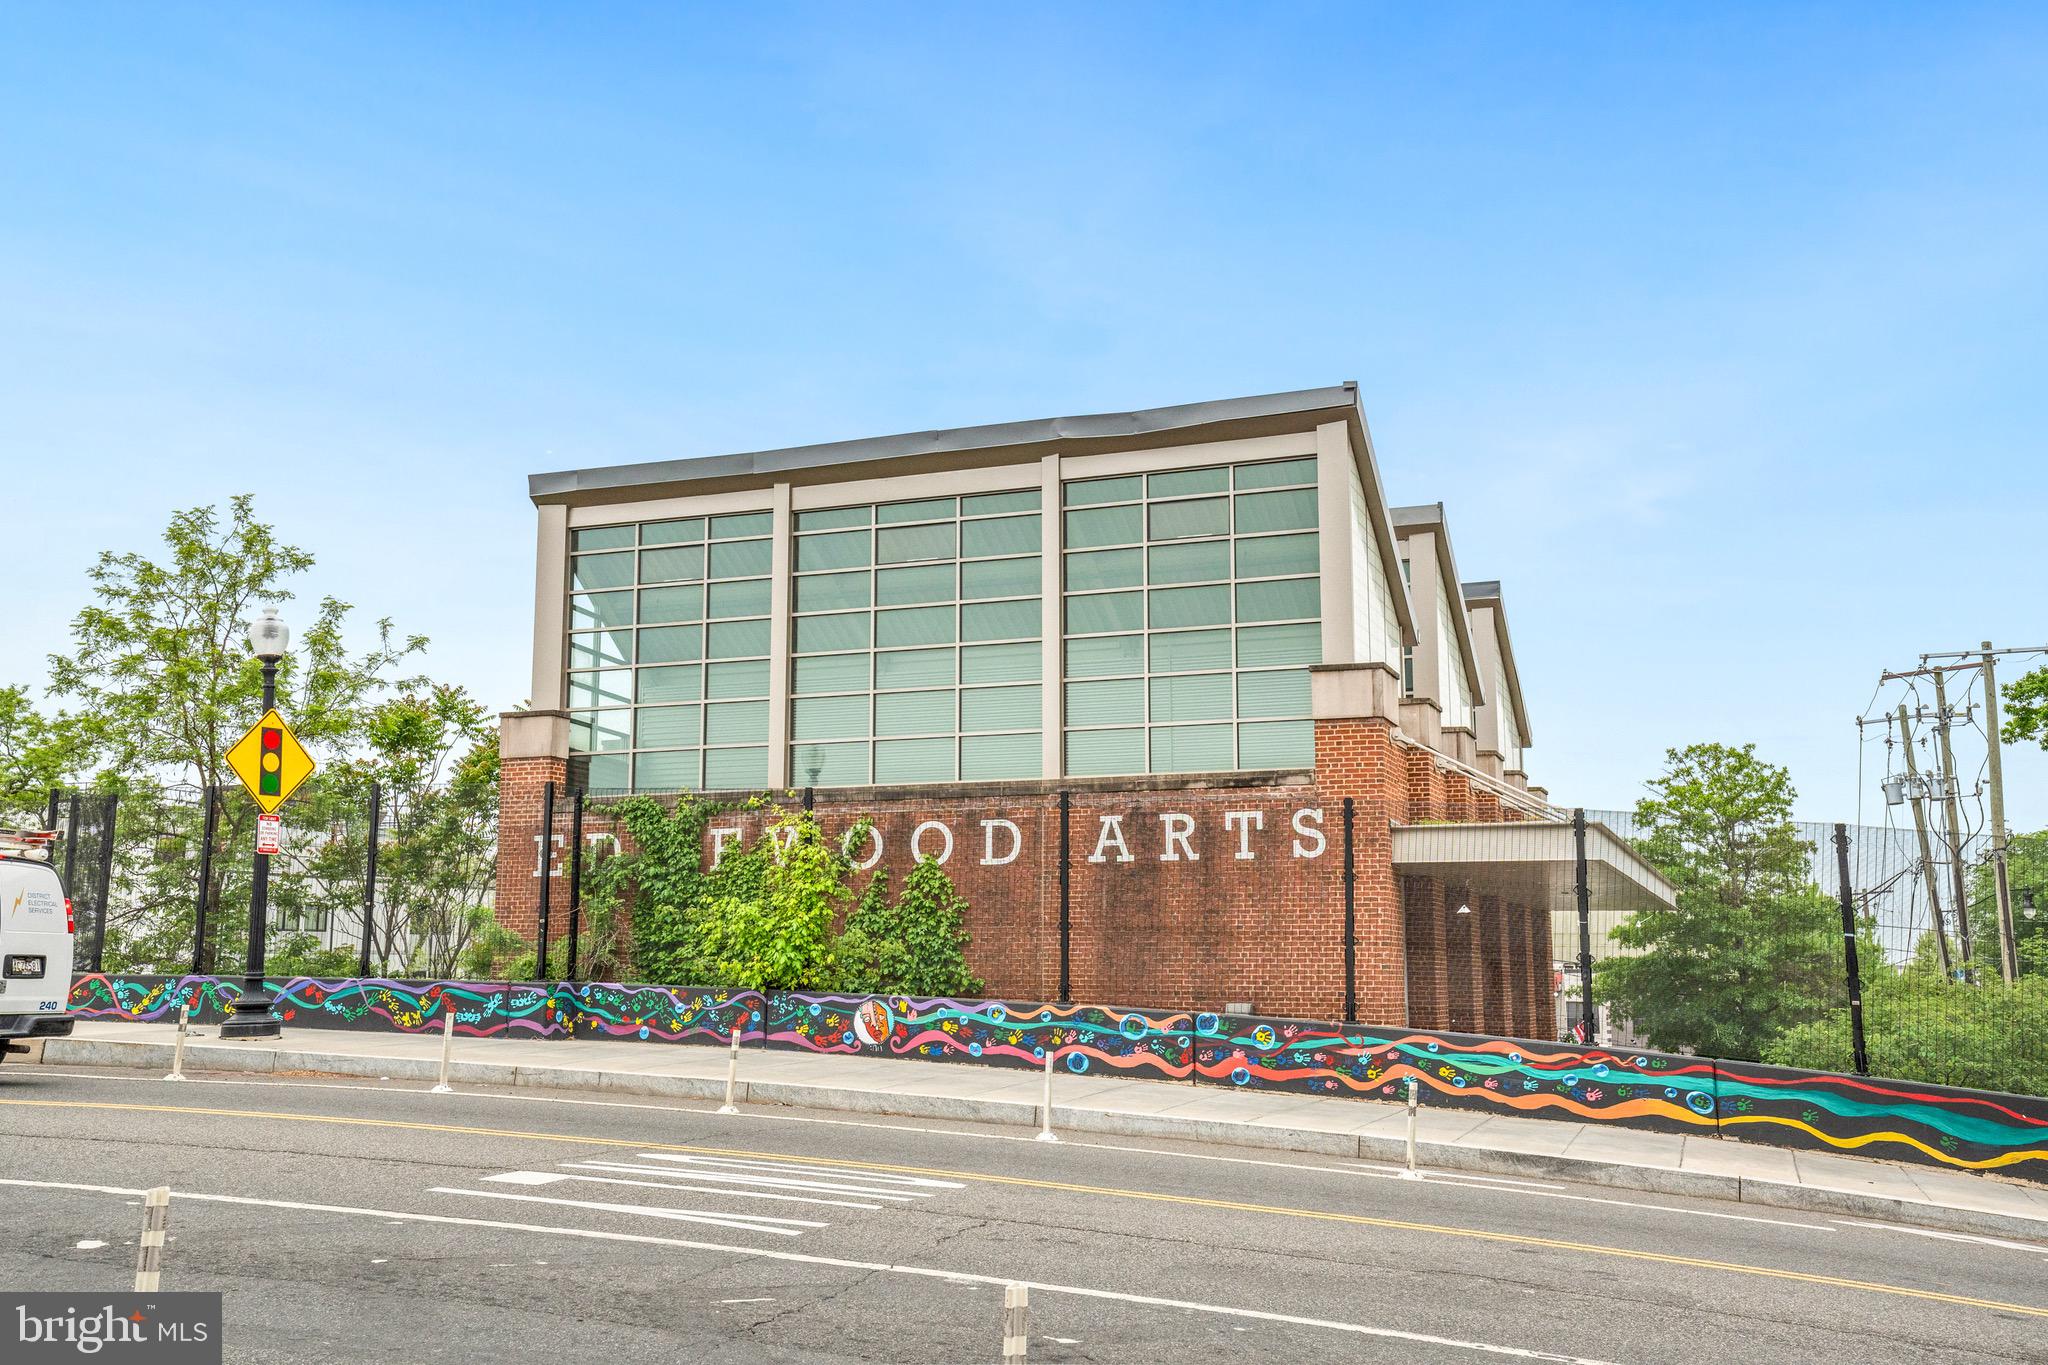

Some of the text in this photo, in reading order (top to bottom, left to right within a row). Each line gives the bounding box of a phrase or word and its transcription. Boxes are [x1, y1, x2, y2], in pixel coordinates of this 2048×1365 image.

[1088, 808, 1327, 863] ARTS
[28, 899, 58, 908] ELECTRICAL
[40, 1001, 57, 1010] 240
